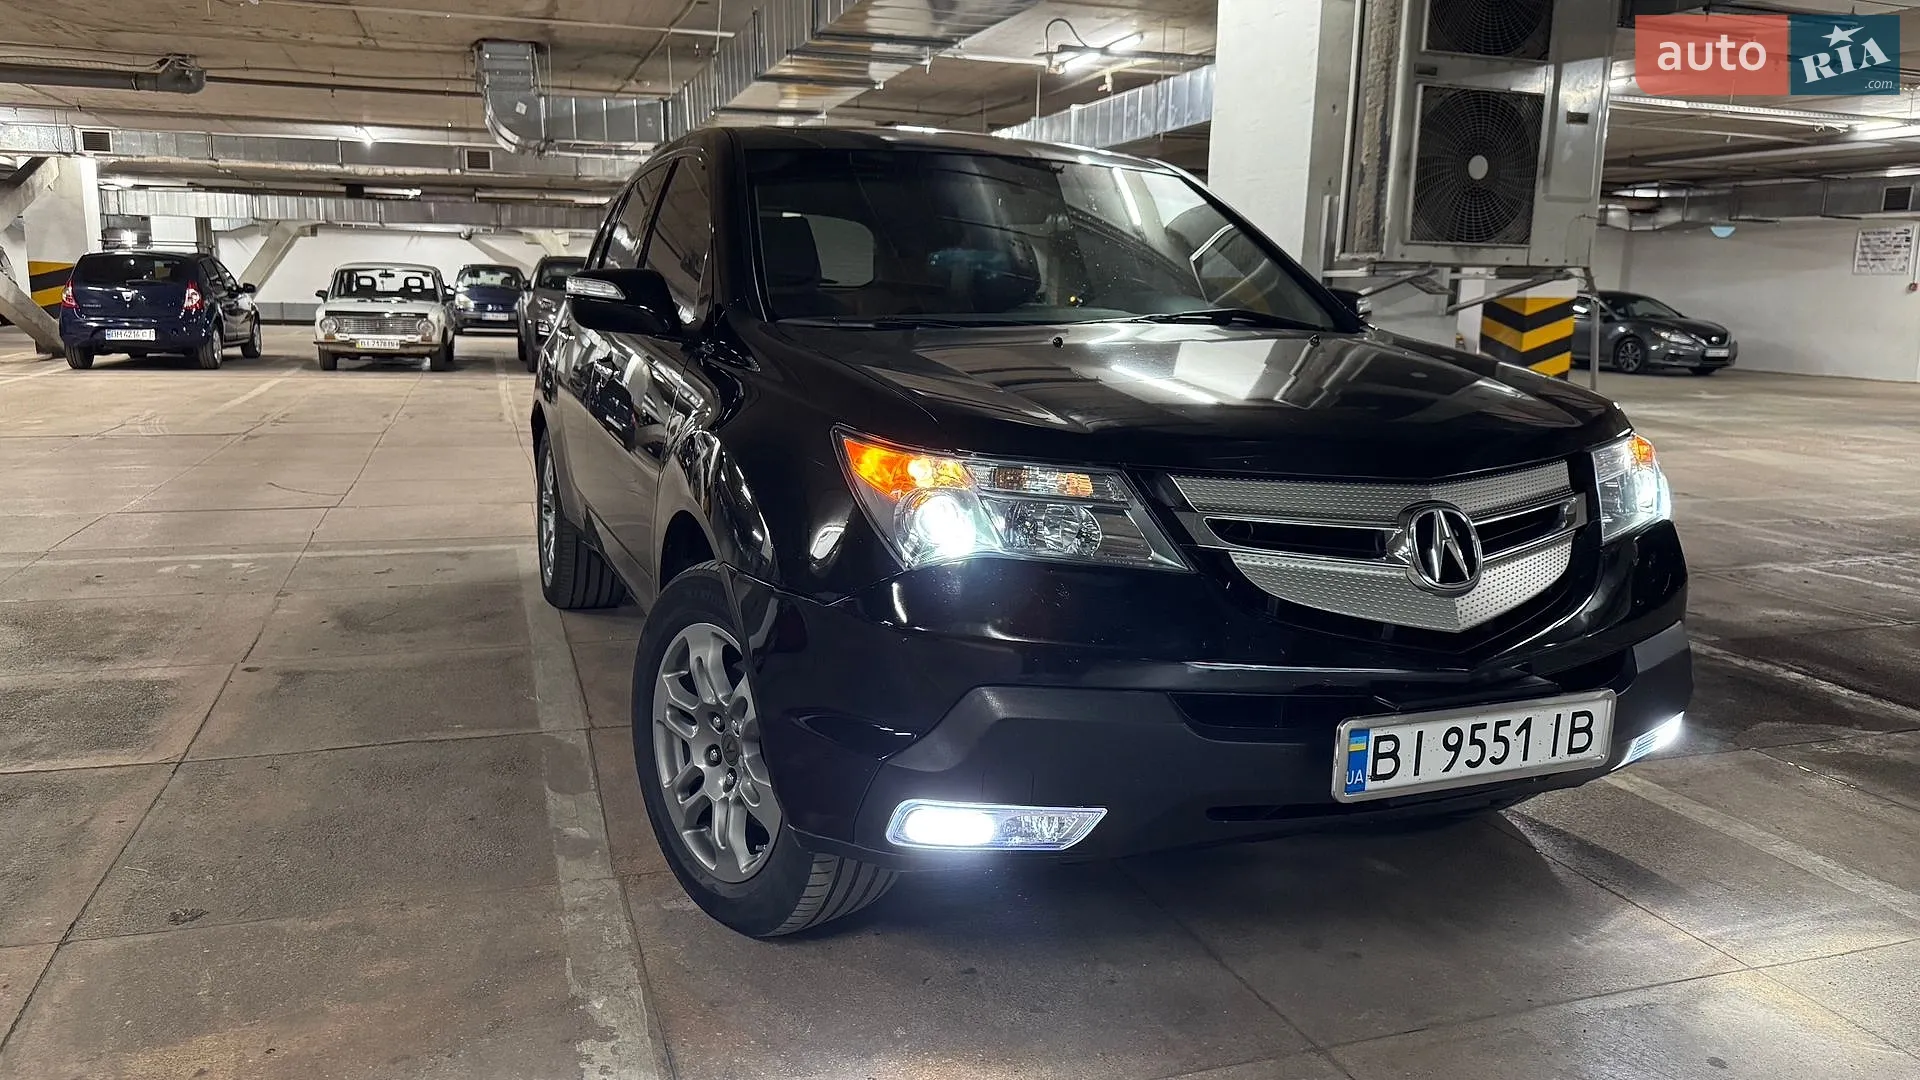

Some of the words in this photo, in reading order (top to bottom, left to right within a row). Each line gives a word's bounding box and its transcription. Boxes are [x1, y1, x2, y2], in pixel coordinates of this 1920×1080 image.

[1371, 730, 1424, 782] BI
[1441, 716, 1533, 773] 9551
[1551, 710, 1594, 758] IB
[1346, 769, 1364, 785] UA
